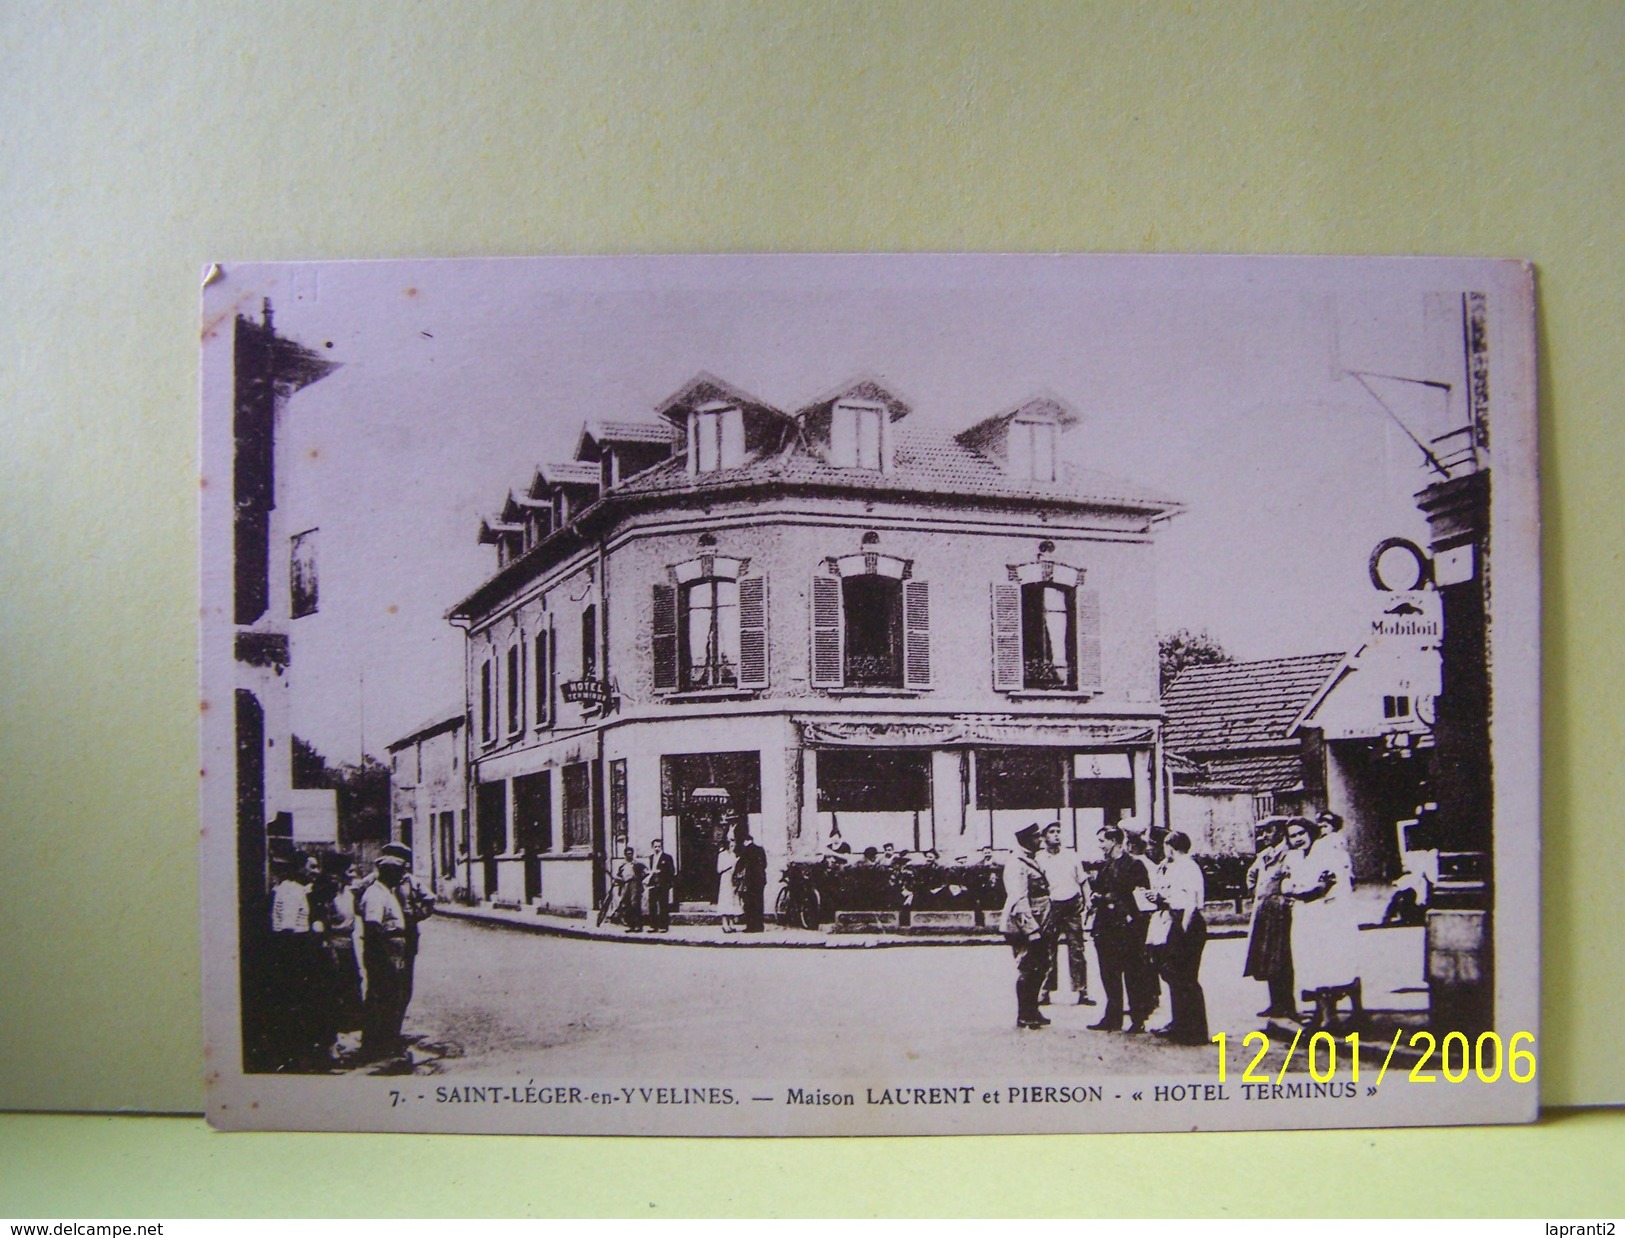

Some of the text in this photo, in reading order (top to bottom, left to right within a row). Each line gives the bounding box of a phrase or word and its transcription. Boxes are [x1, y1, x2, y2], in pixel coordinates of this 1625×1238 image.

[1371, 620, 1438, 635] Mobiloil
[570, 682, 603, 692] HOTEL
[786, 1087, 855, 1106] Maison
[866, 1086, 975, 1105] LAURENT
[982, 1088, 1001, 1104] et
[1008, 1085, 1103, 1104] PIERSON
[1154, 1084, 1230, 1101] HOTEL
[1241, 1081, 1358, 1101] TERMINUS
